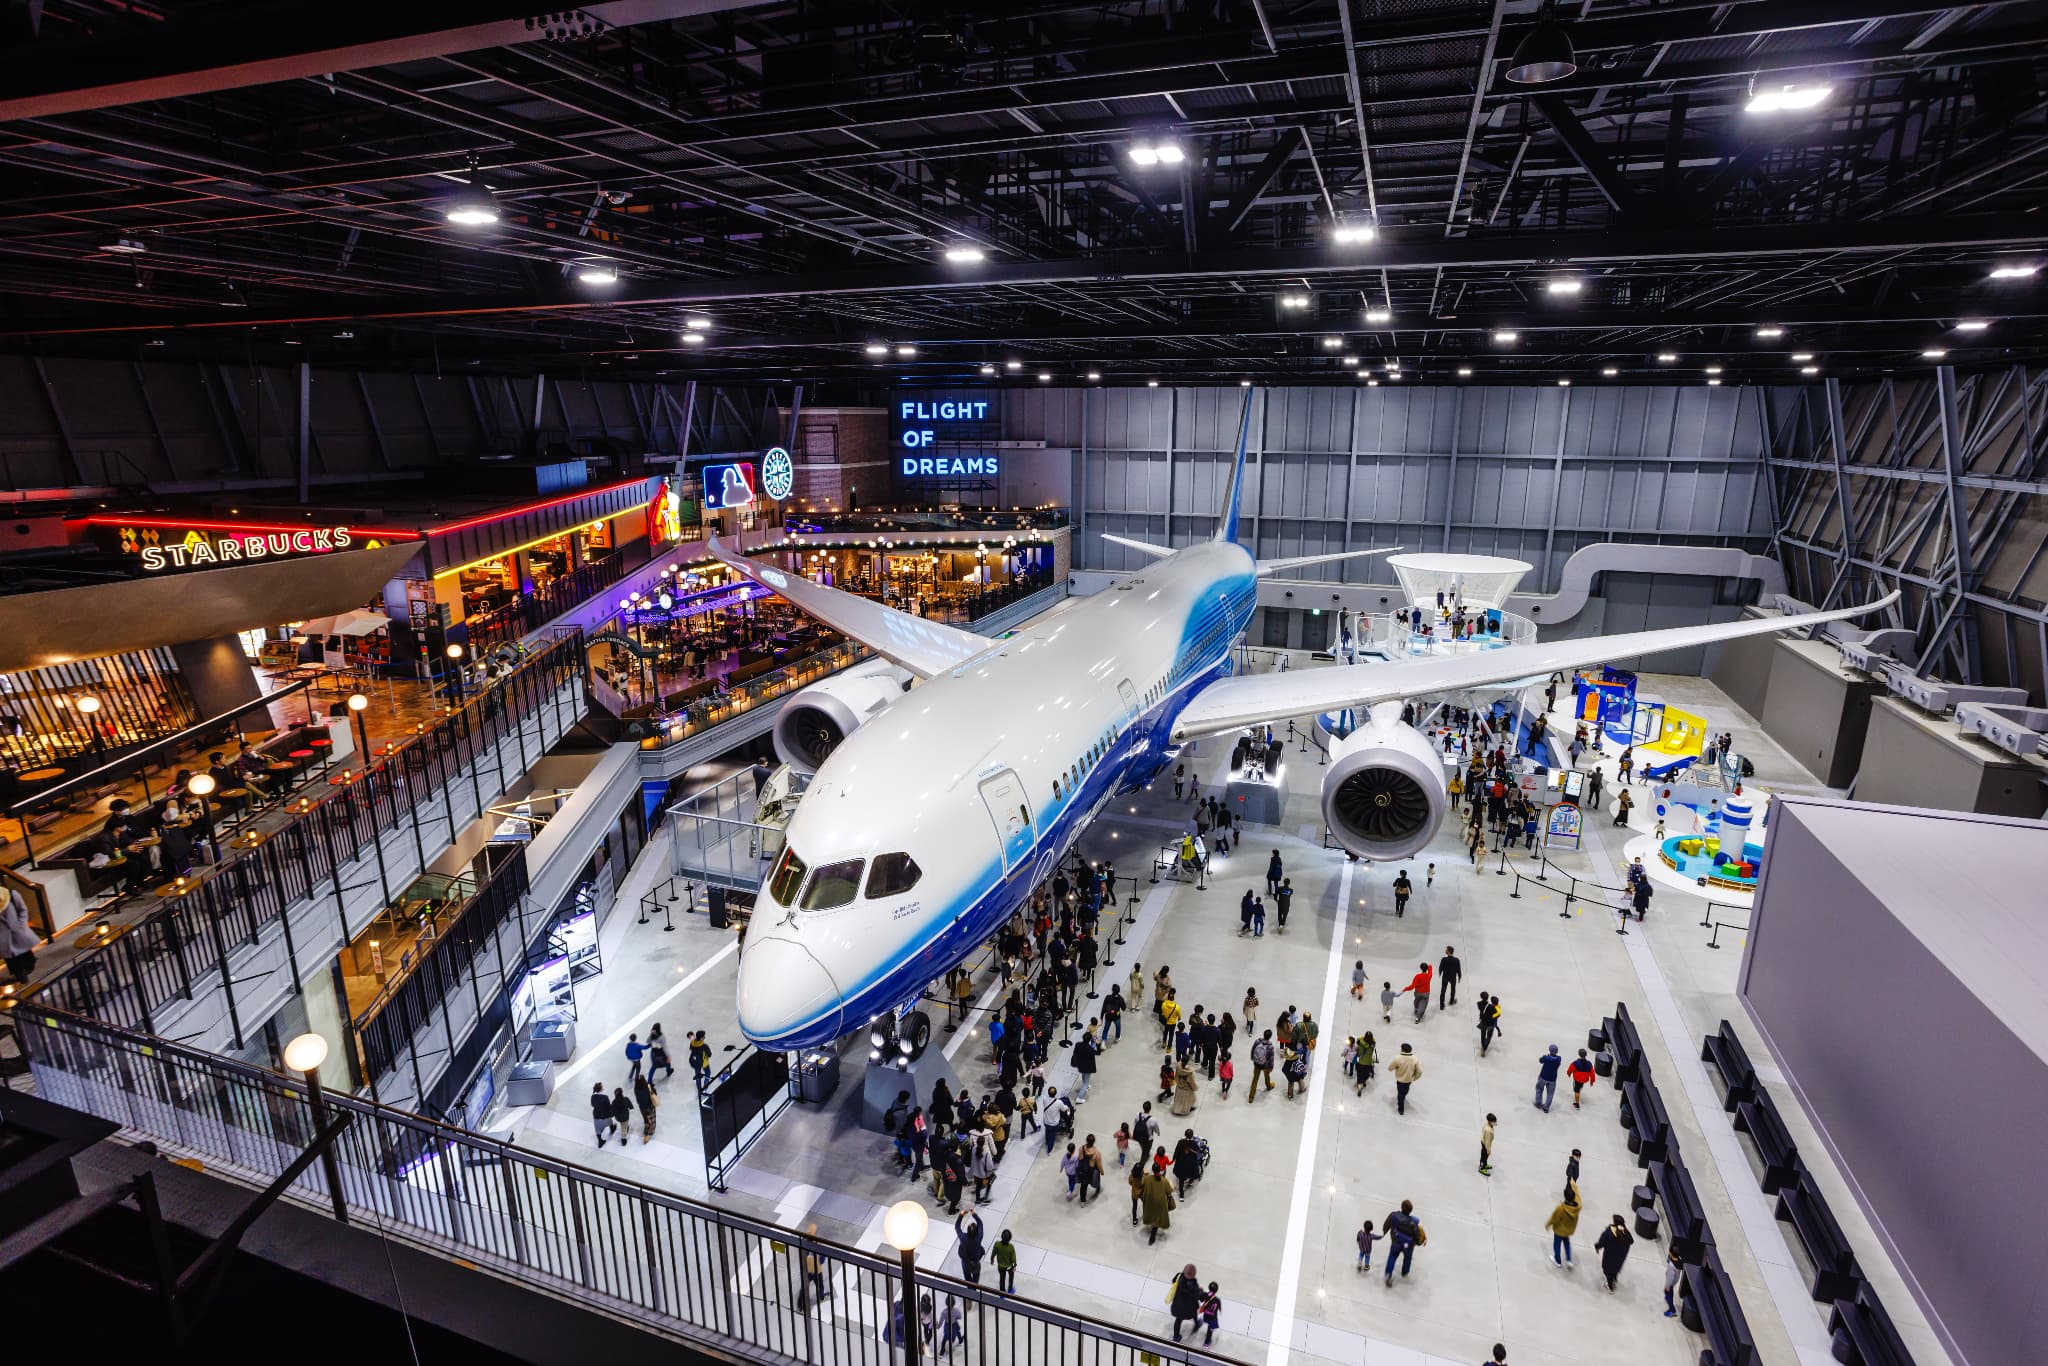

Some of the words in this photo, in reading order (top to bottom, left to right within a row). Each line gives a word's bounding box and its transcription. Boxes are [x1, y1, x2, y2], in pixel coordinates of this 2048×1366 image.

[902, 402, 987, 419] FLIGHT
[903, 430, 934, 447] OF
[903, 458, 998, 475] DREAMS
[141, 527, 351, 570] STARBUCKS
